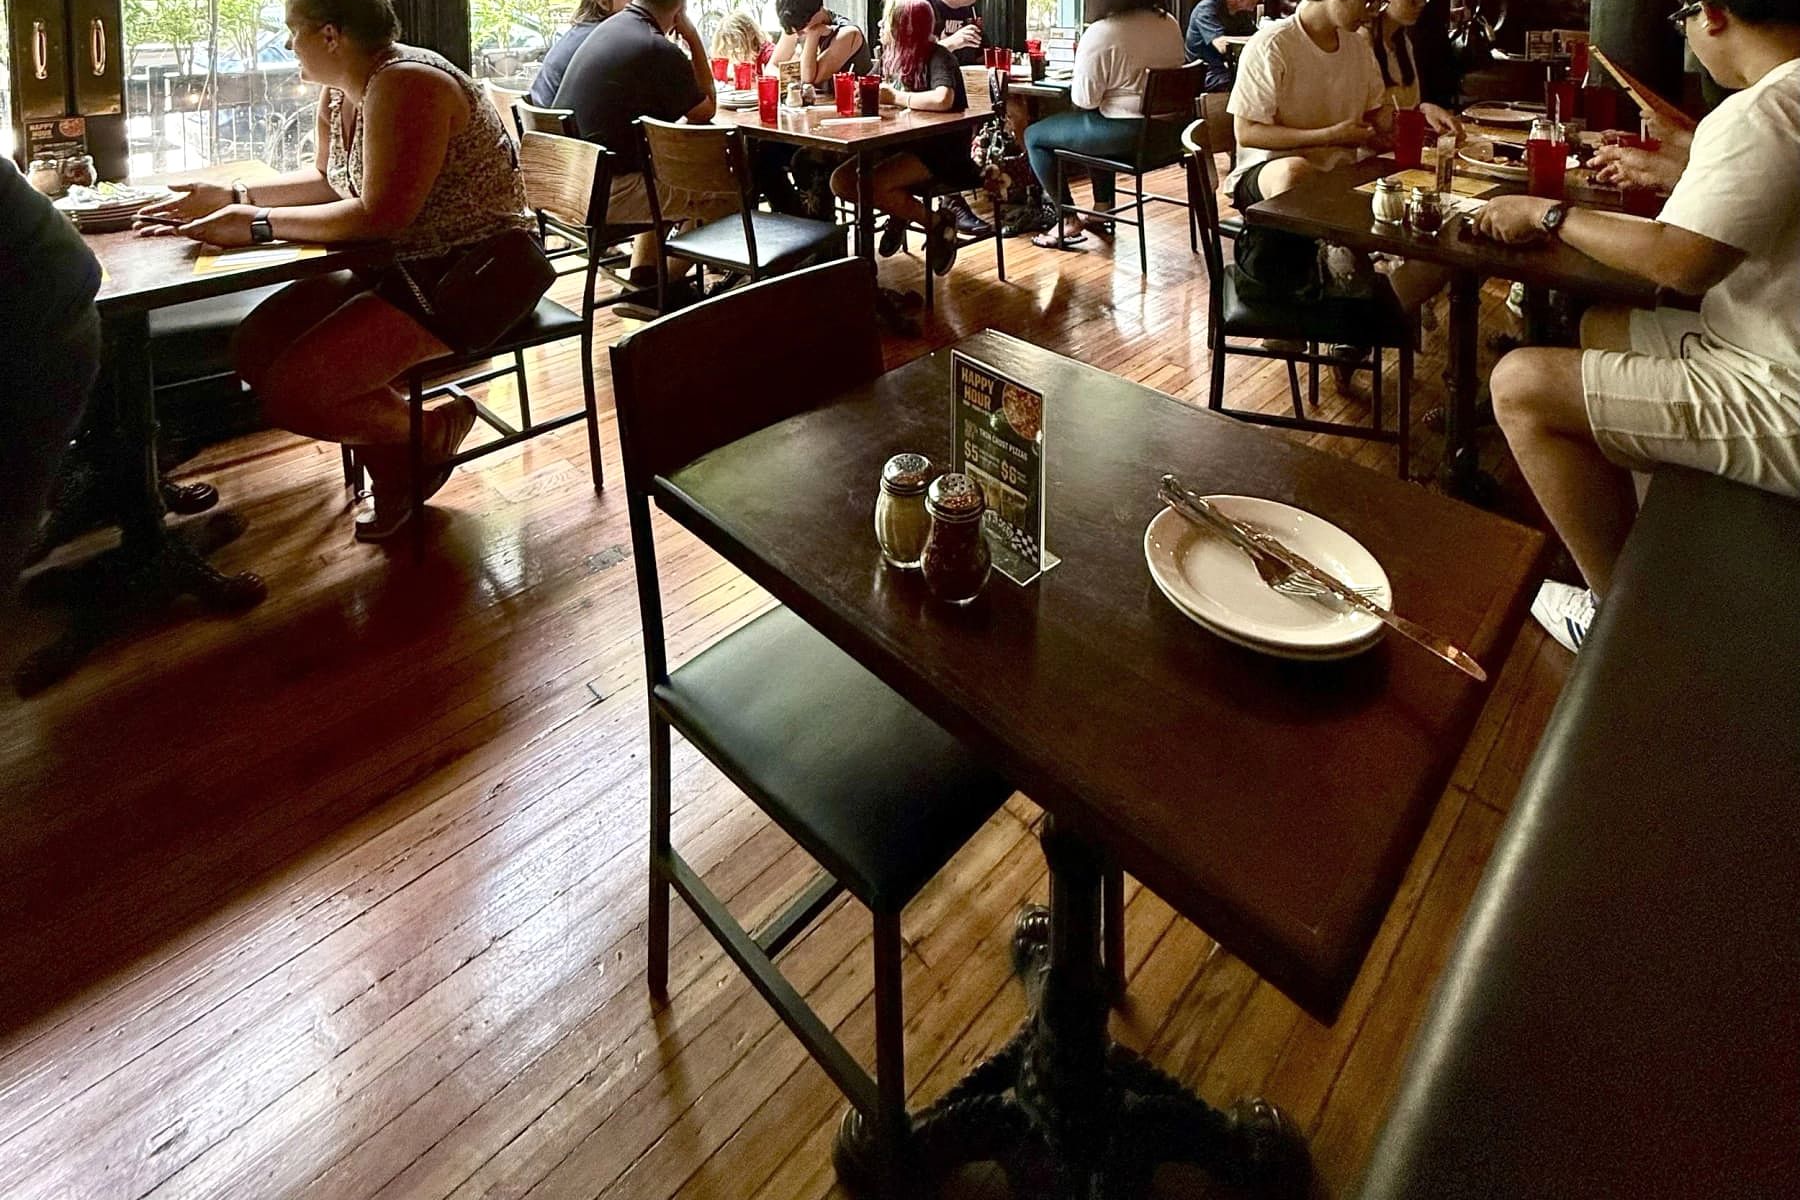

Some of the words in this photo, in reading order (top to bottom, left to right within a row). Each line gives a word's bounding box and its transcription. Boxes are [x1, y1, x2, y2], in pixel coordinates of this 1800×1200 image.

[961, 366, 994, 395] HAPPY
[964, 384, 991, 411] HOUR
[964, 439, 979, 462] $5
[1001, 460, 1017, 484] $6
